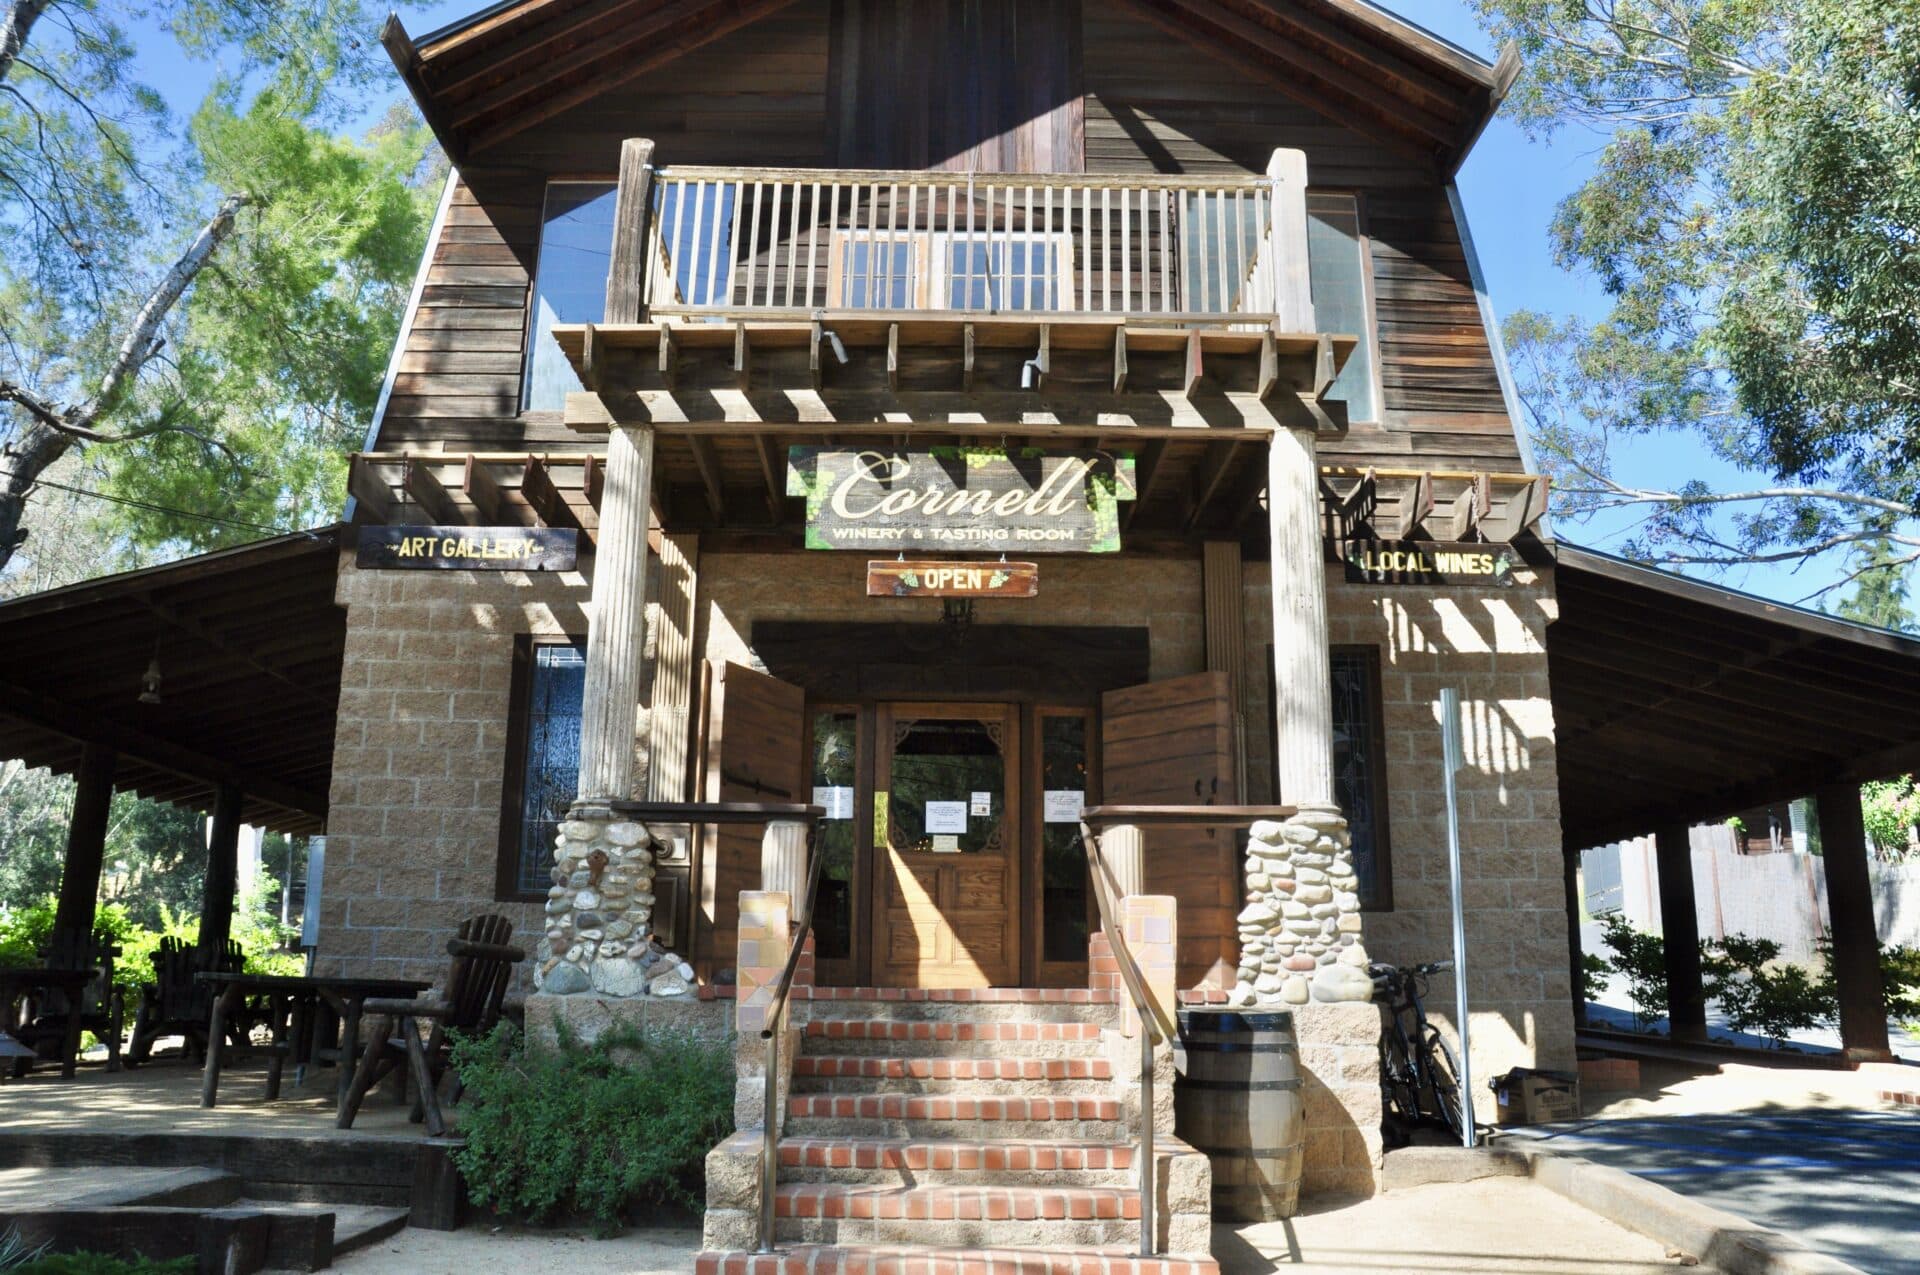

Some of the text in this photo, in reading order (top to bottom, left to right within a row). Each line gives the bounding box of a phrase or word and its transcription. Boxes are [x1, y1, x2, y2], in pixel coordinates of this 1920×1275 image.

[830, 451, 1098, 519] Cornell
[832, 527, 1074, 541] WINERY & TASTING ROOM
[399, 537, 533, 560] ART GALLERY
[1366, 551, 1494, 575] LOCAL WINES
[923, 568, 982, 590] OPEN
